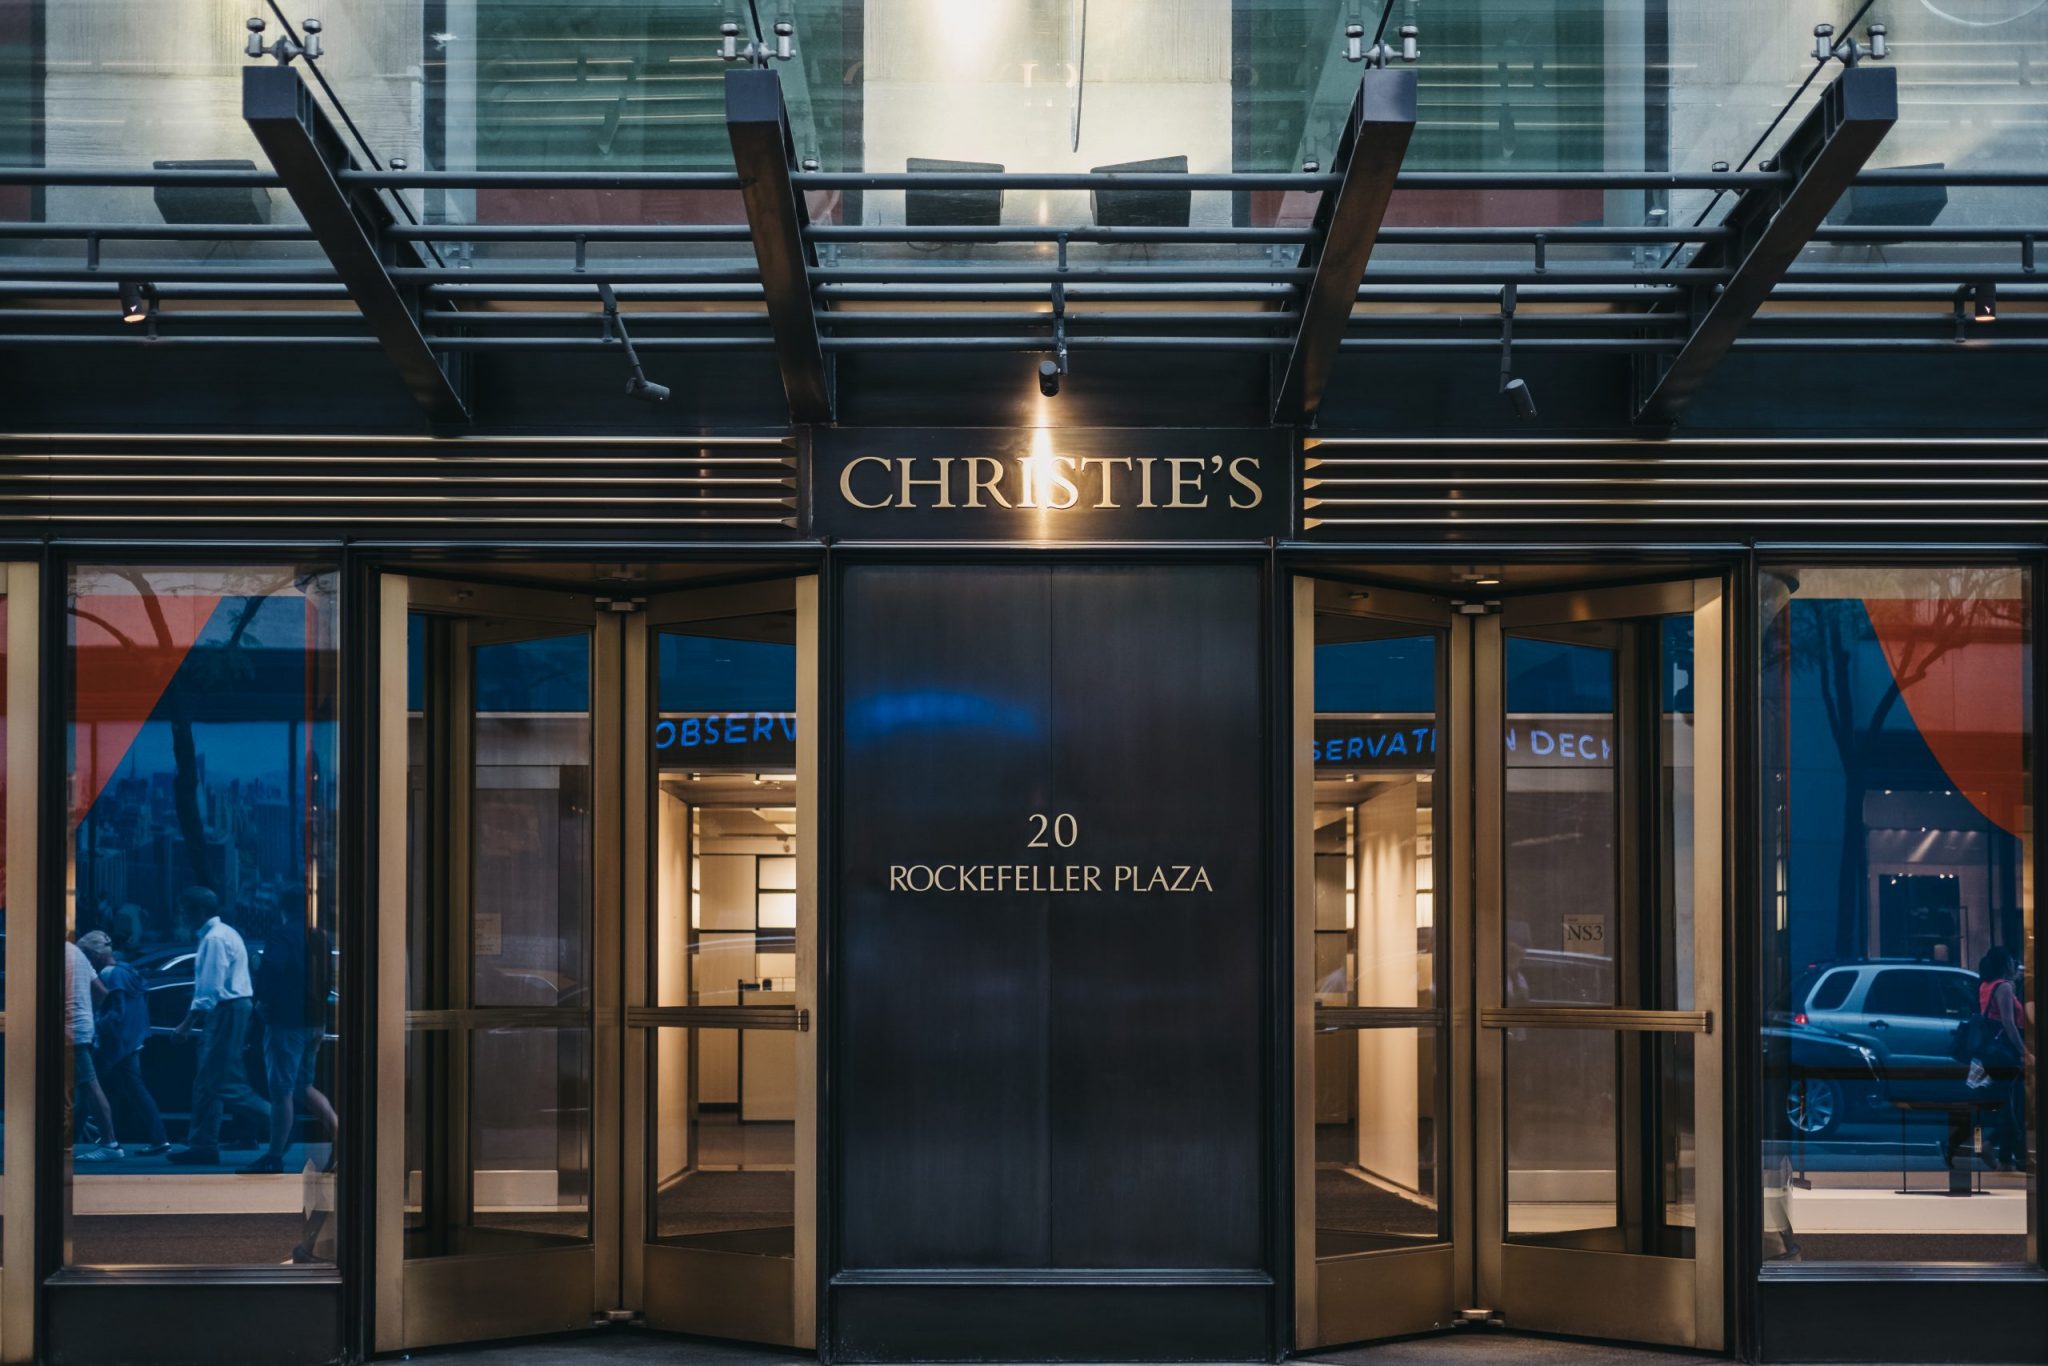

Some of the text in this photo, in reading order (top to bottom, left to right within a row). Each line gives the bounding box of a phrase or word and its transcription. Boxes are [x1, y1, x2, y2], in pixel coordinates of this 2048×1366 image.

[840, 457, 1263, 510] CHRISTIE'S
[1027, 813, 1078, 848] 20
[890, 864, 1213, 892] ROCKEFELLER PLAZA
[1567, 925, 1603, 941] NS3
